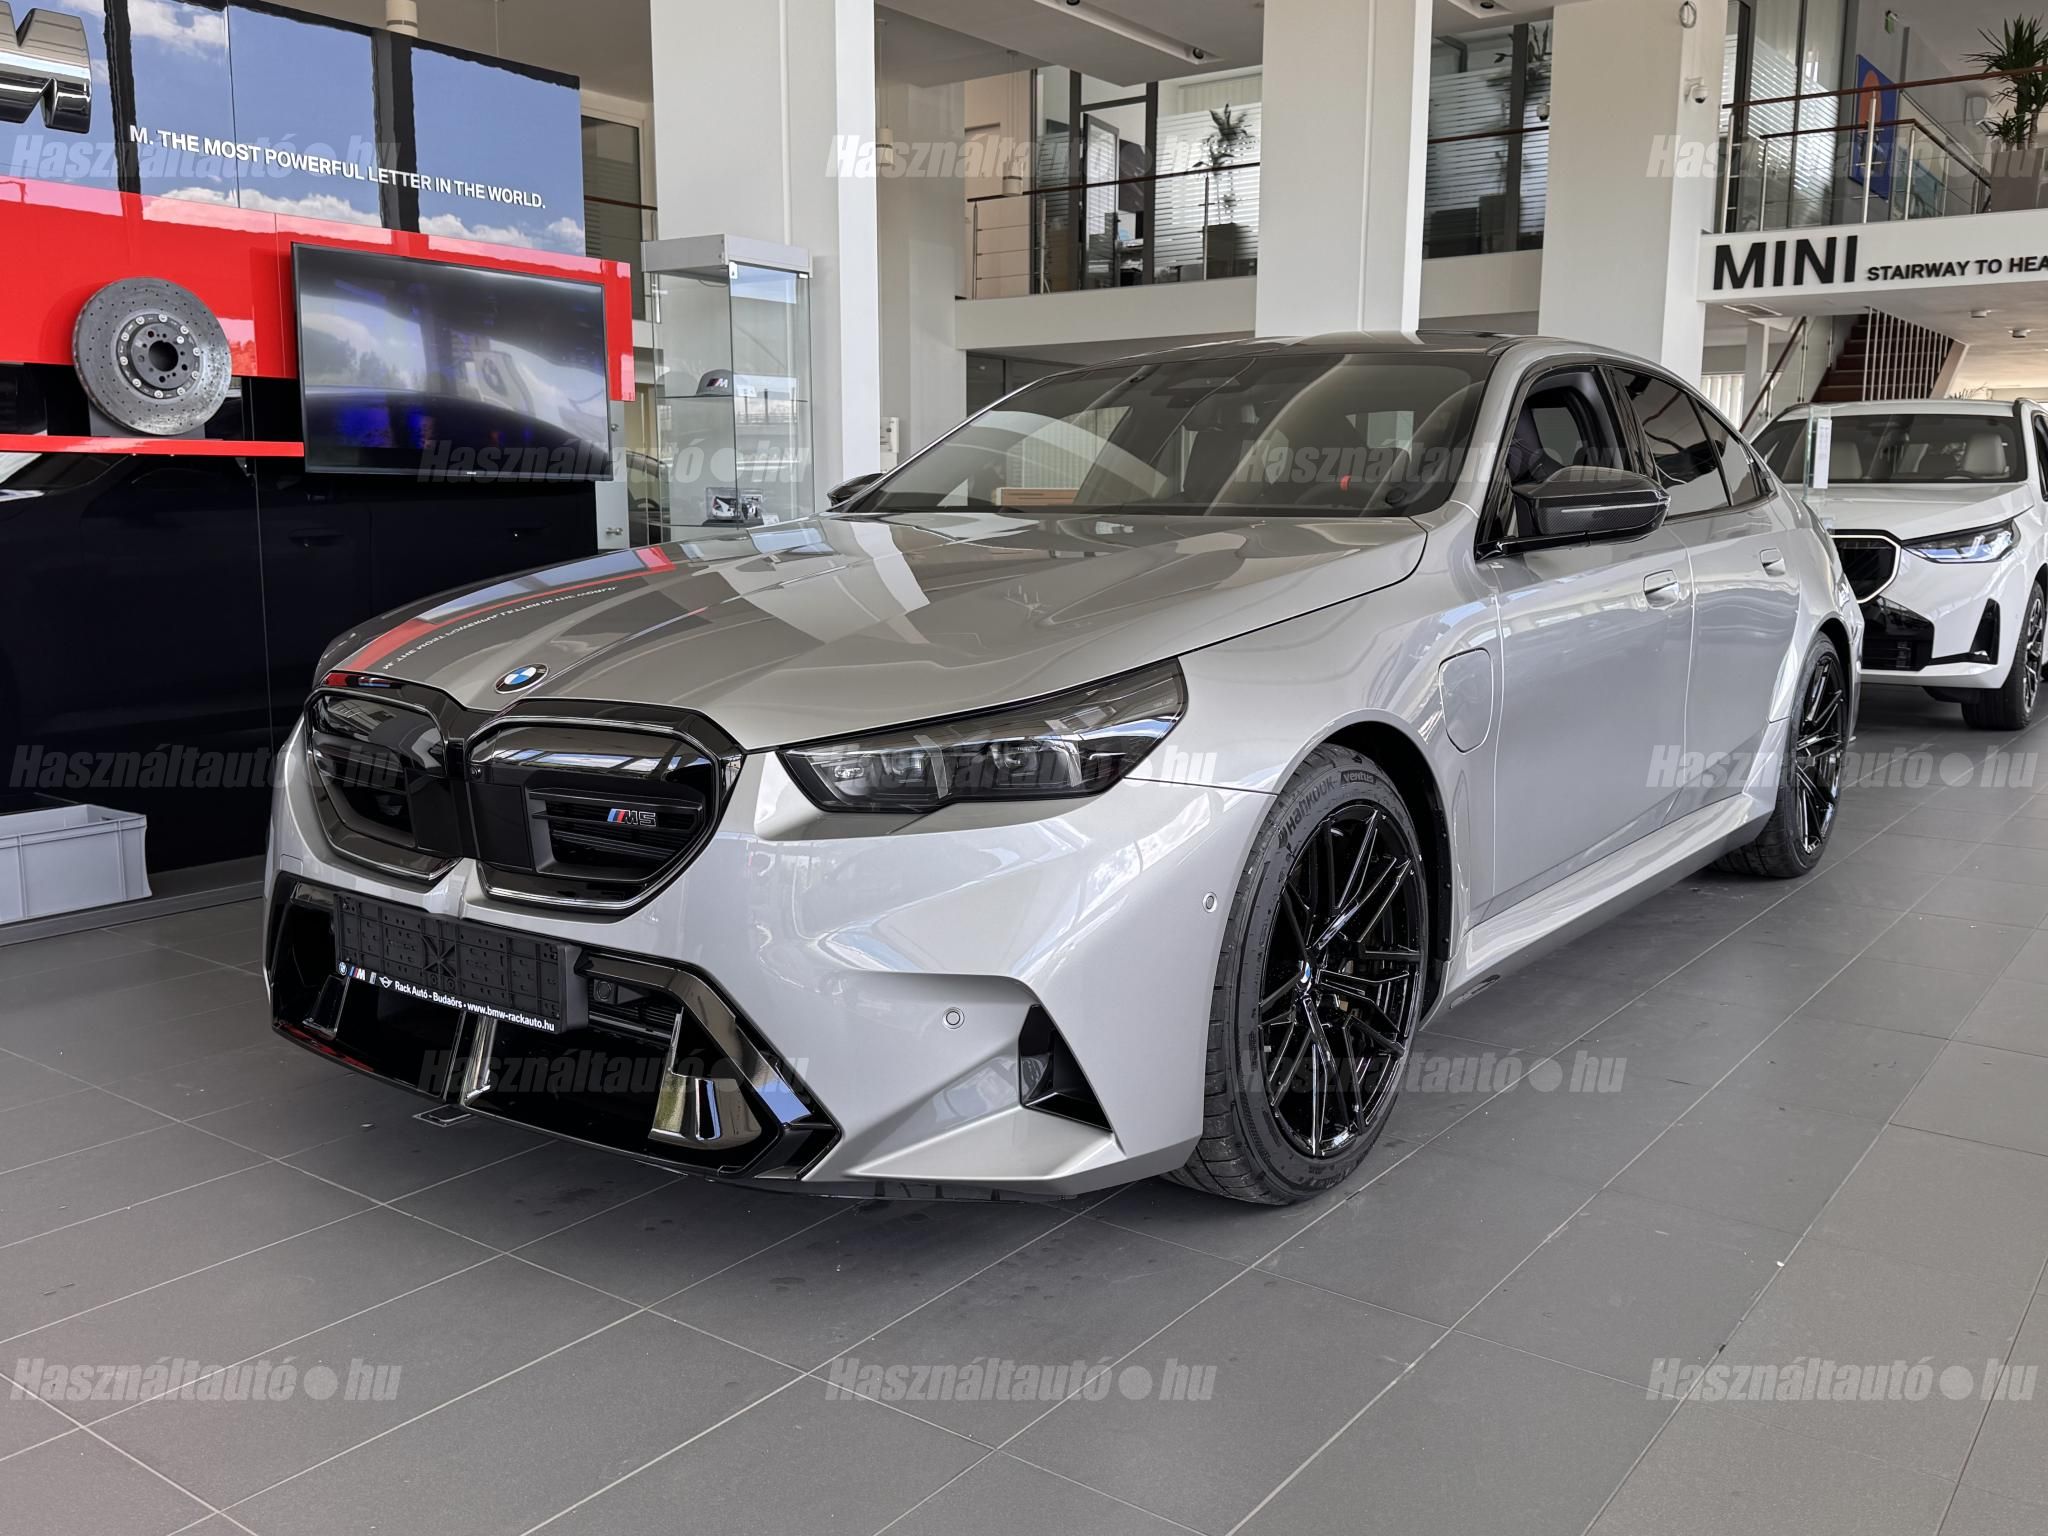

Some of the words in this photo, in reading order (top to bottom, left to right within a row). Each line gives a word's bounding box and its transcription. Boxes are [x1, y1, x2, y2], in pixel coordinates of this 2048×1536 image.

[129, 124, 154, 145] M.
[157, 129, 200, 153] THE
[204, 137, 261, 163] MOST
[265, 147, 365, 181] POWERFUL
[368, 166, 432, 191] LETTER
[435, 177, 452, 194] IN
[454, 180, 486, 199] THE
[487, 185, 547, 209] WORLD.
[1713, 235, 1859, 291] MINI
[1867, 260, 1971, 281] STAIRWAY
[1974, 258, 2002, 276] TO
[394, 981, 412, 994] Rack
[411, 985, 428, 999] Autó
[467, 1002, 555, 1032] www.bmw-rackauto.hu
